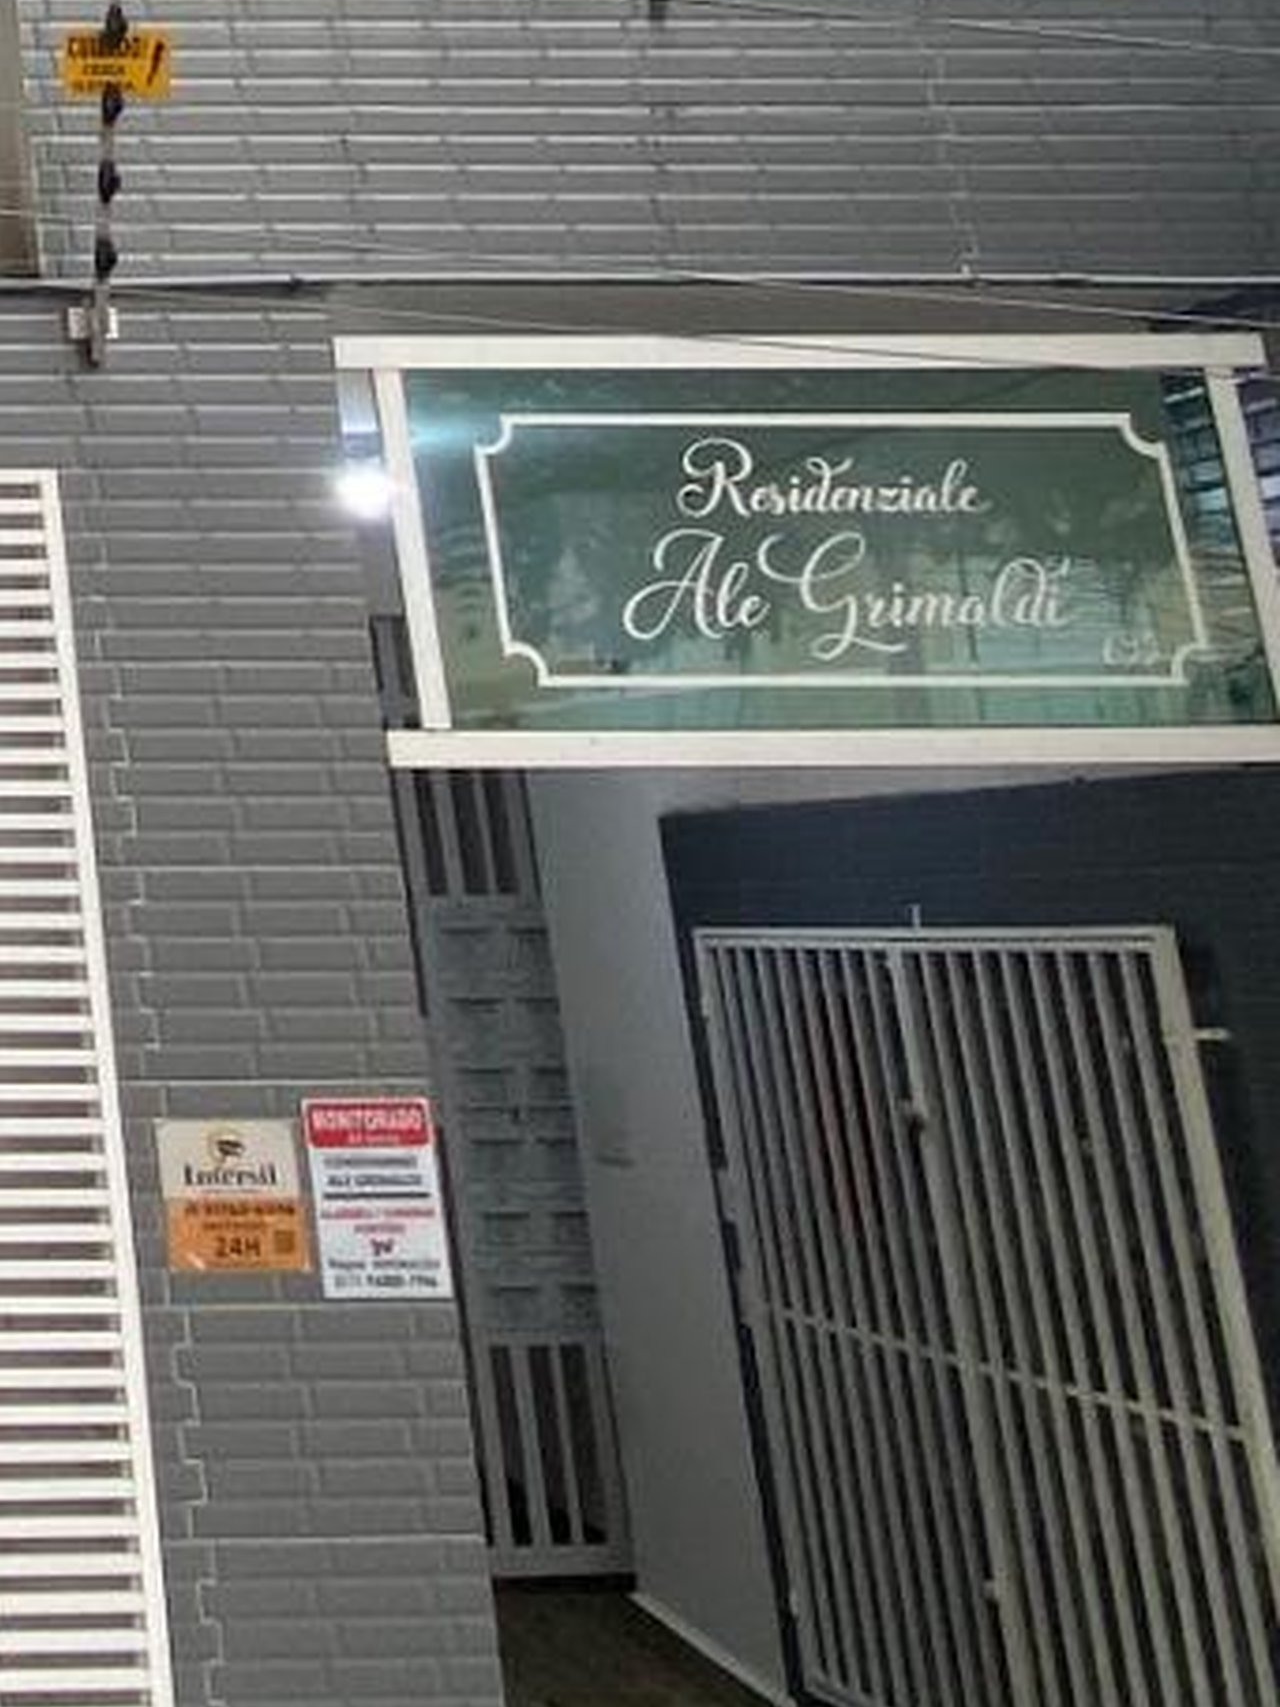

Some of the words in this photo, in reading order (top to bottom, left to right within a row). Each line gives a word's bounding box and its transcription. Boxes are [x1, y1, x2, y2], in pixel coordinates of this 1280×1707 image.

[676, 437, 992, 517] Residenziale
[622, 528, 769, 639] Ale
[757, 531, 1073, 661] Grimaldi
